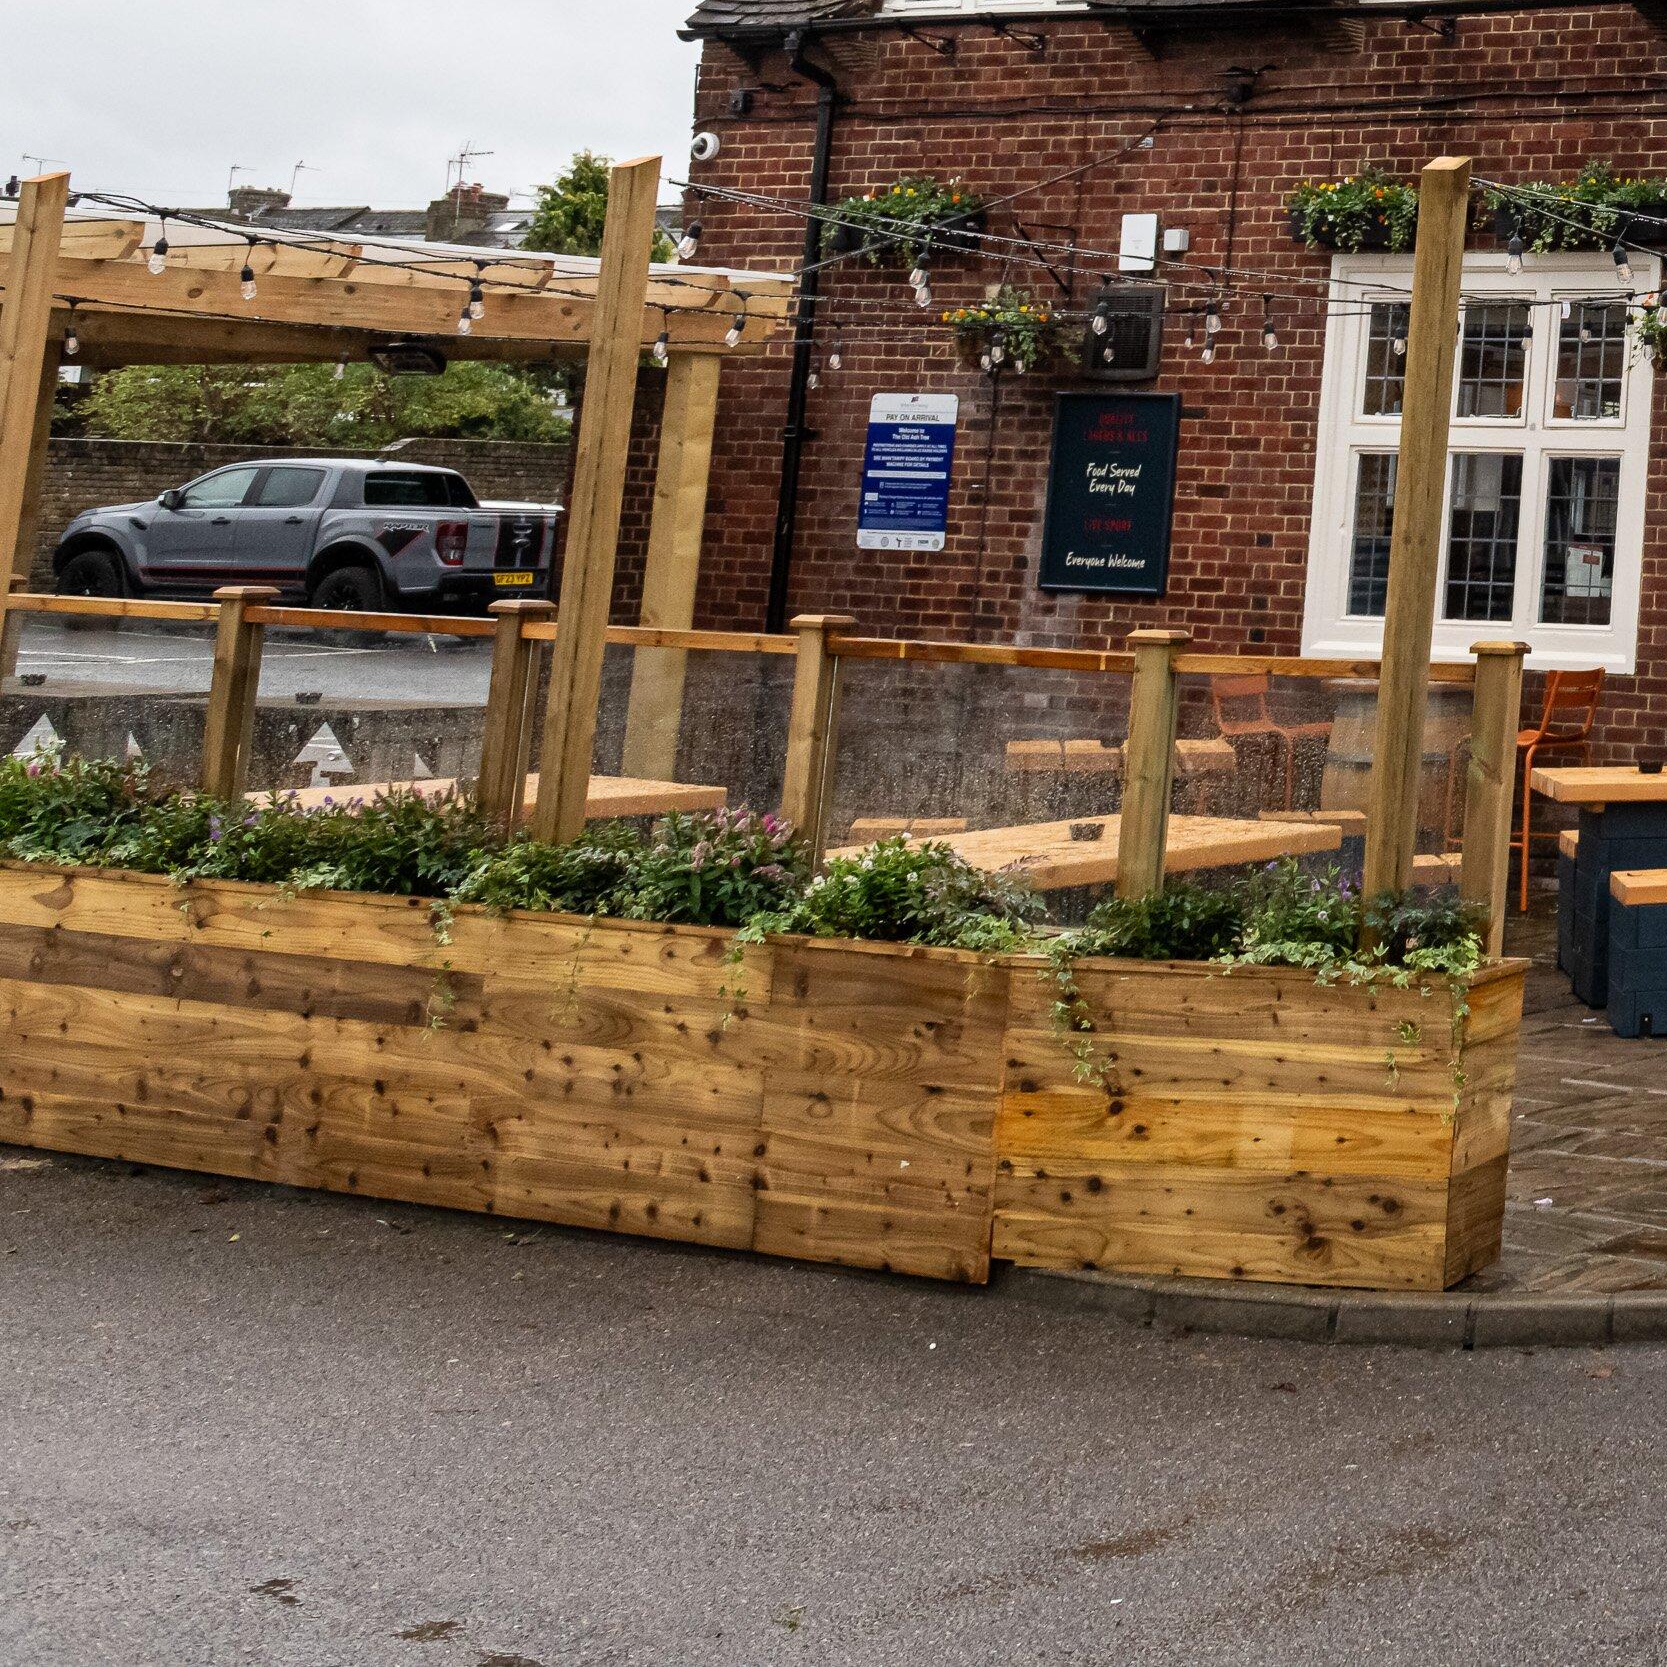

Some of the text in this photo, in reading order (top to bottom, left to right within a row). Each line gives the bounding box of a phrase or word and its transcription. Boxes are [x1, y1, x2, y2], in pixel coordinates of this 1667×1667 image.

[911, 414, 940, 422] ARRIVAL
[1086, 462, 1142, 478] Food Served
[1089, 478, 1136, 497] Every Day
[383, 521, 430, 534] RAPTOR
[1065, 551, 1146, 570] Everyone Welcome
